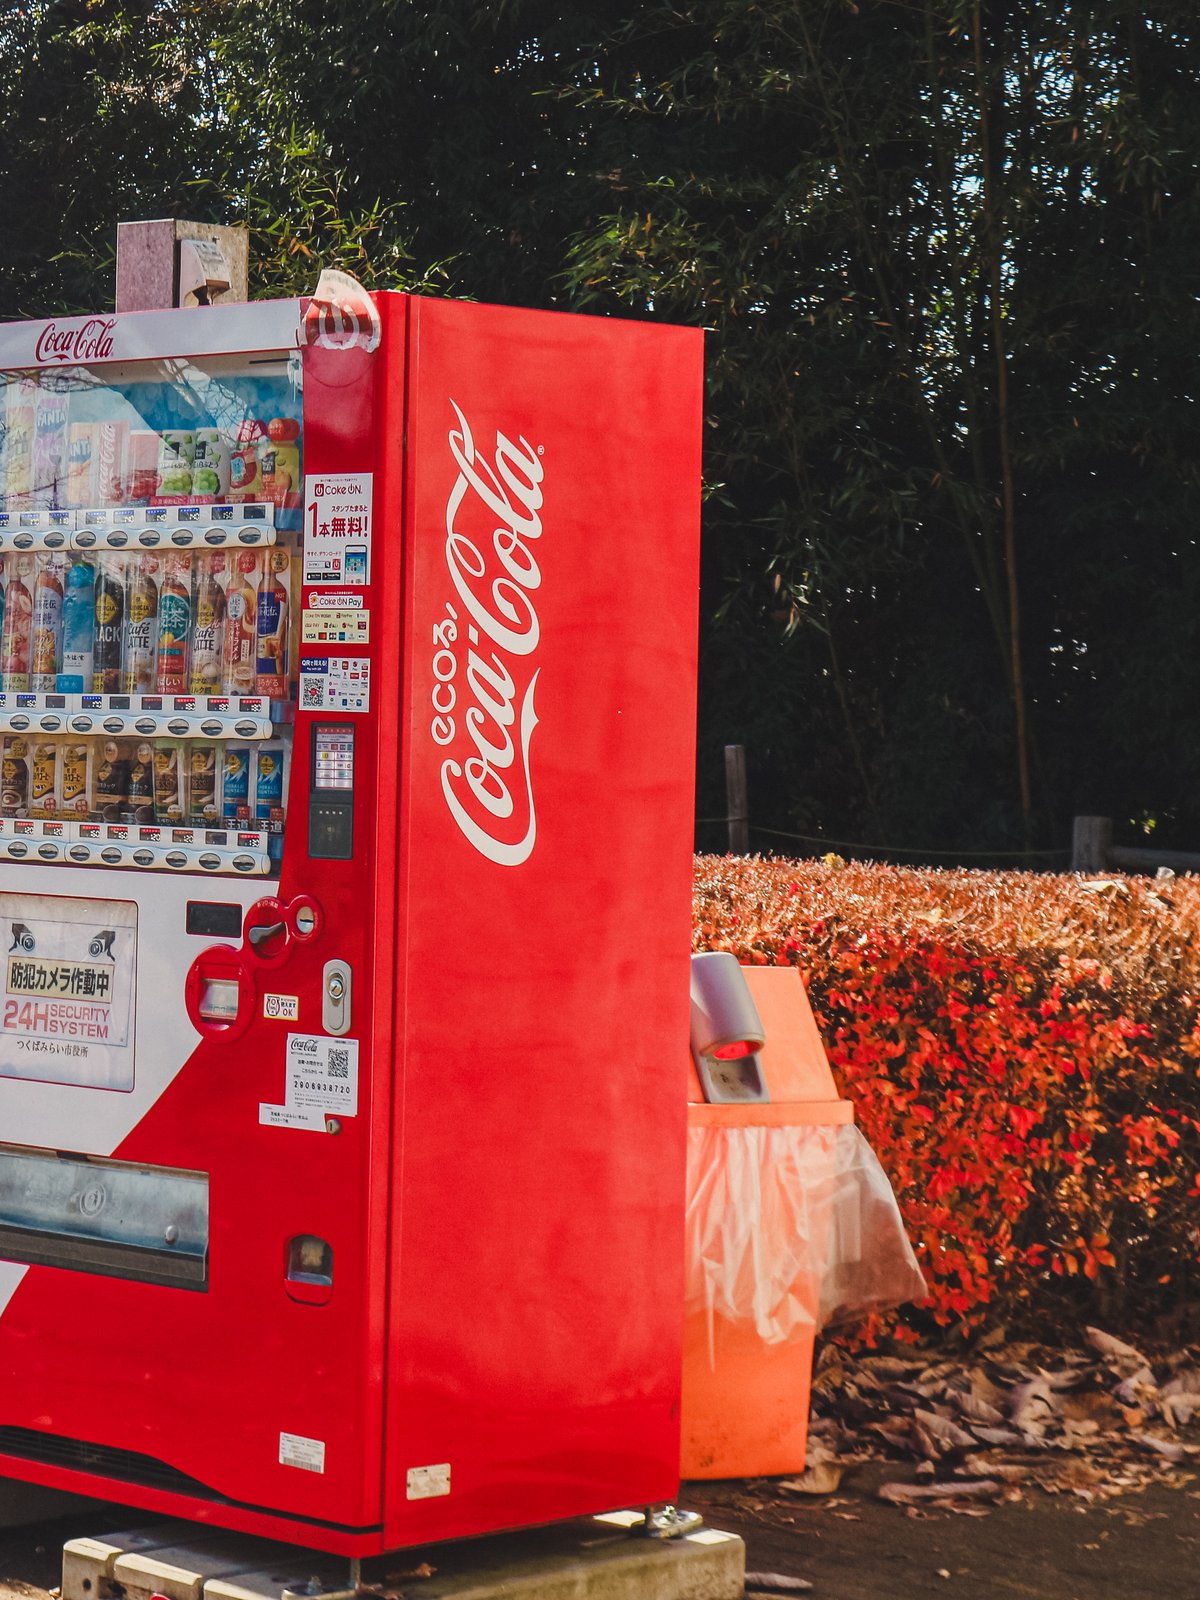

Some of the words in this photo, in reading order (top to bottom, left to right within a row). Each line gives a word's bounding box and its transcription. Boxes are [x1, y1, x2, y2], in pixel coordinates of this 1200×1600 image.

[36, 319, 118, 362] Coca-Cola
[37, 409, 66, 427] FANTA
[325, 485, 346, 495] Coke
[308, 502, 368, 538] 1本無料!
[320, 597, 336, 606] Coke
[349, 598, 362, 607] Pay
[441, 397, 544, 867] Coca-Cola
[226, 819, 249, 831] 王道
[260, 821, 283, 833] 王道
[10, 962, 110, 997] 防犯カメラ作動中
[3, 1000, 49, 1032] 24H
[50, 1003, 110, 1022] SECURITY
[282, 1008, 293, 1016] OK
[49, 1020, 109, 1038] SYSTEM
[17, 1040, 88, 1058] つくばみらい市役所
[291, 1038, 318, 1052] Coca-Cola
